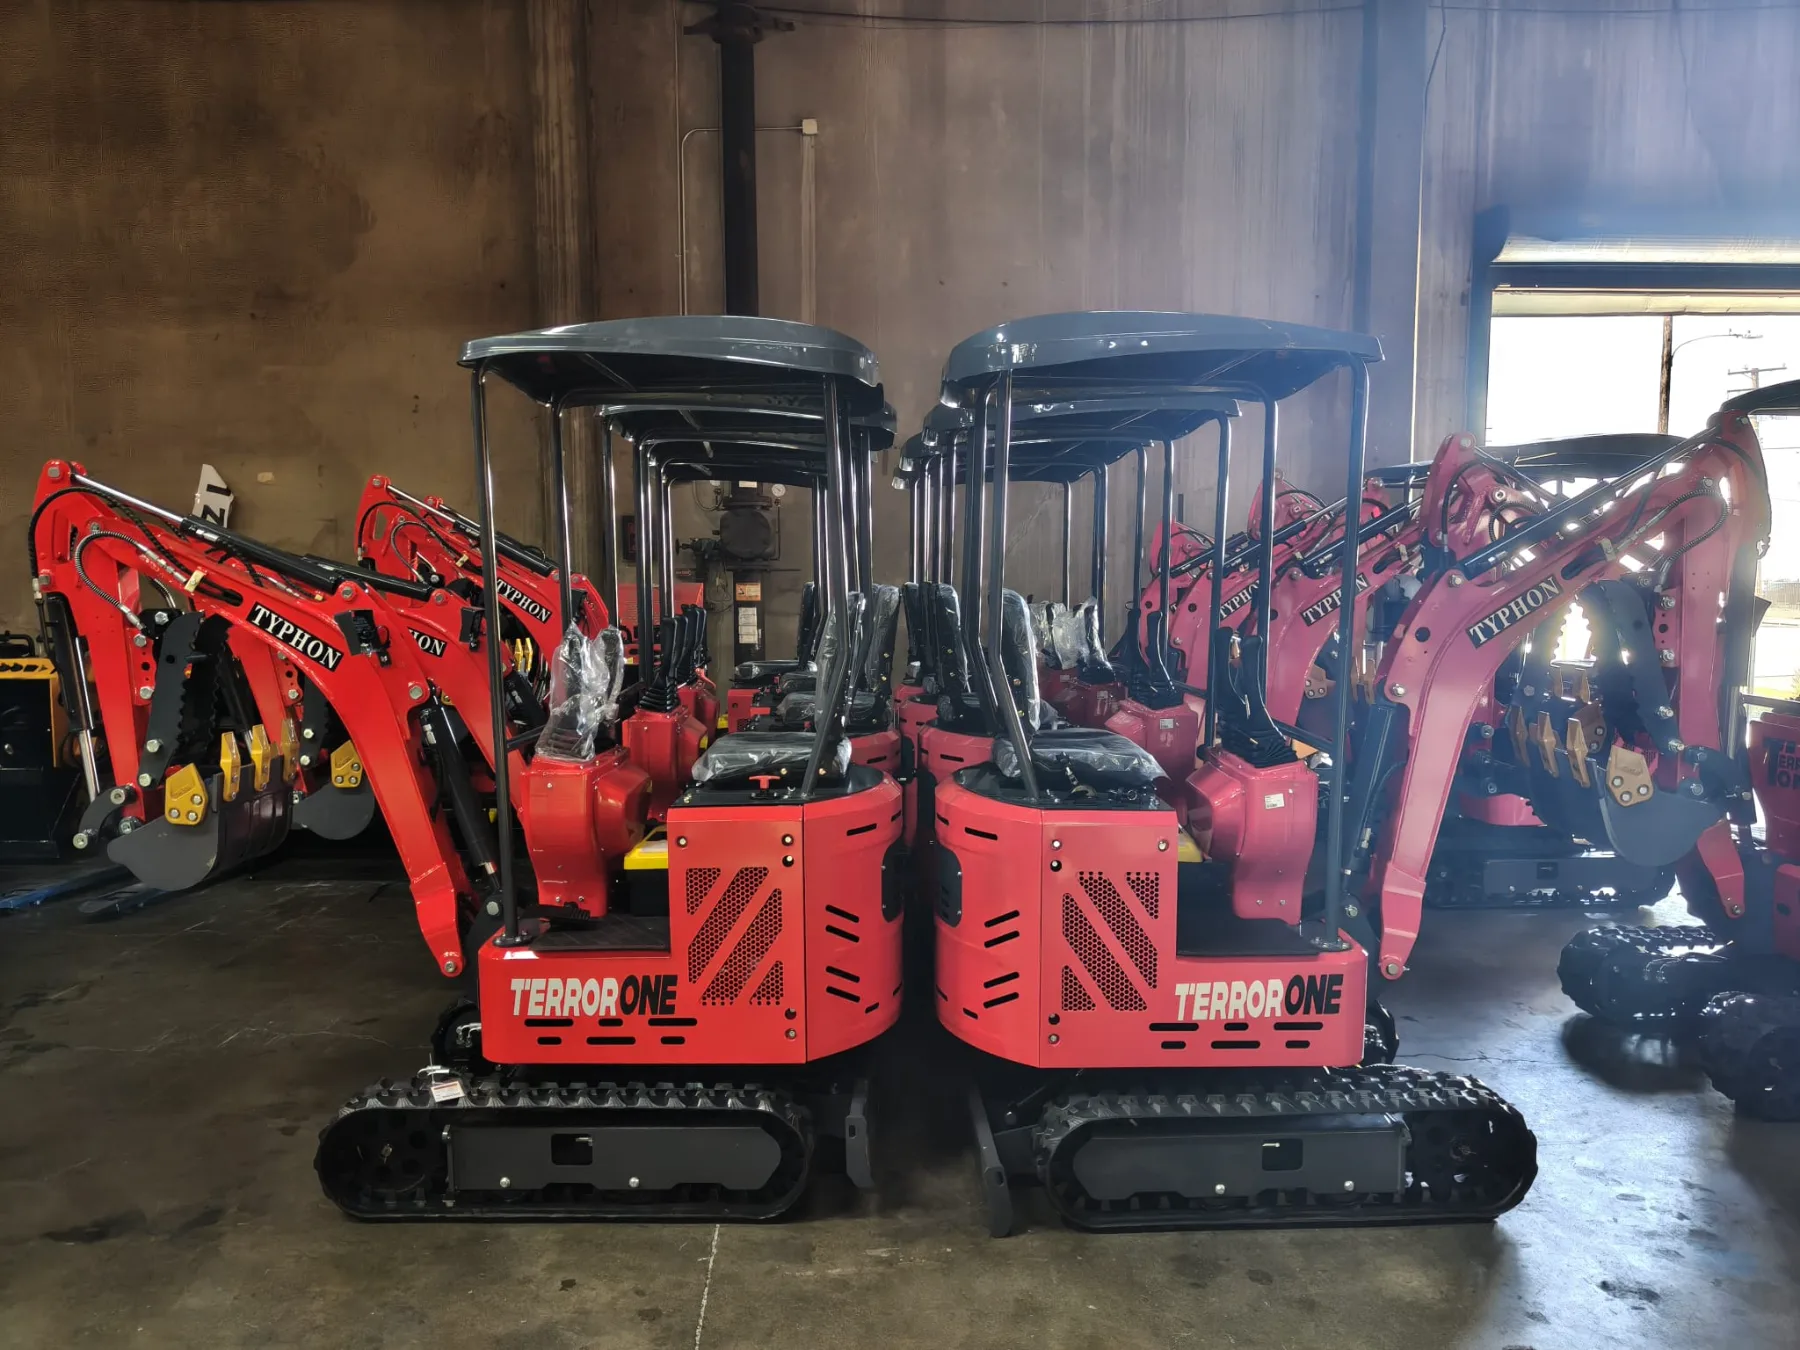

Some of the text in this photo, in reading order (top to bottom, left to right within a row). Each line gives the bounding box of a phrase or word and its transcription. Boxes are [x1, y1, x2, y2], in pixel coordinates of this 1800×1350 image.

[497, 579, 551, 622] TYPHON
[1469, 576, 1560, 644] TYPHON
[251, 604, 341, 669] TYPHON
